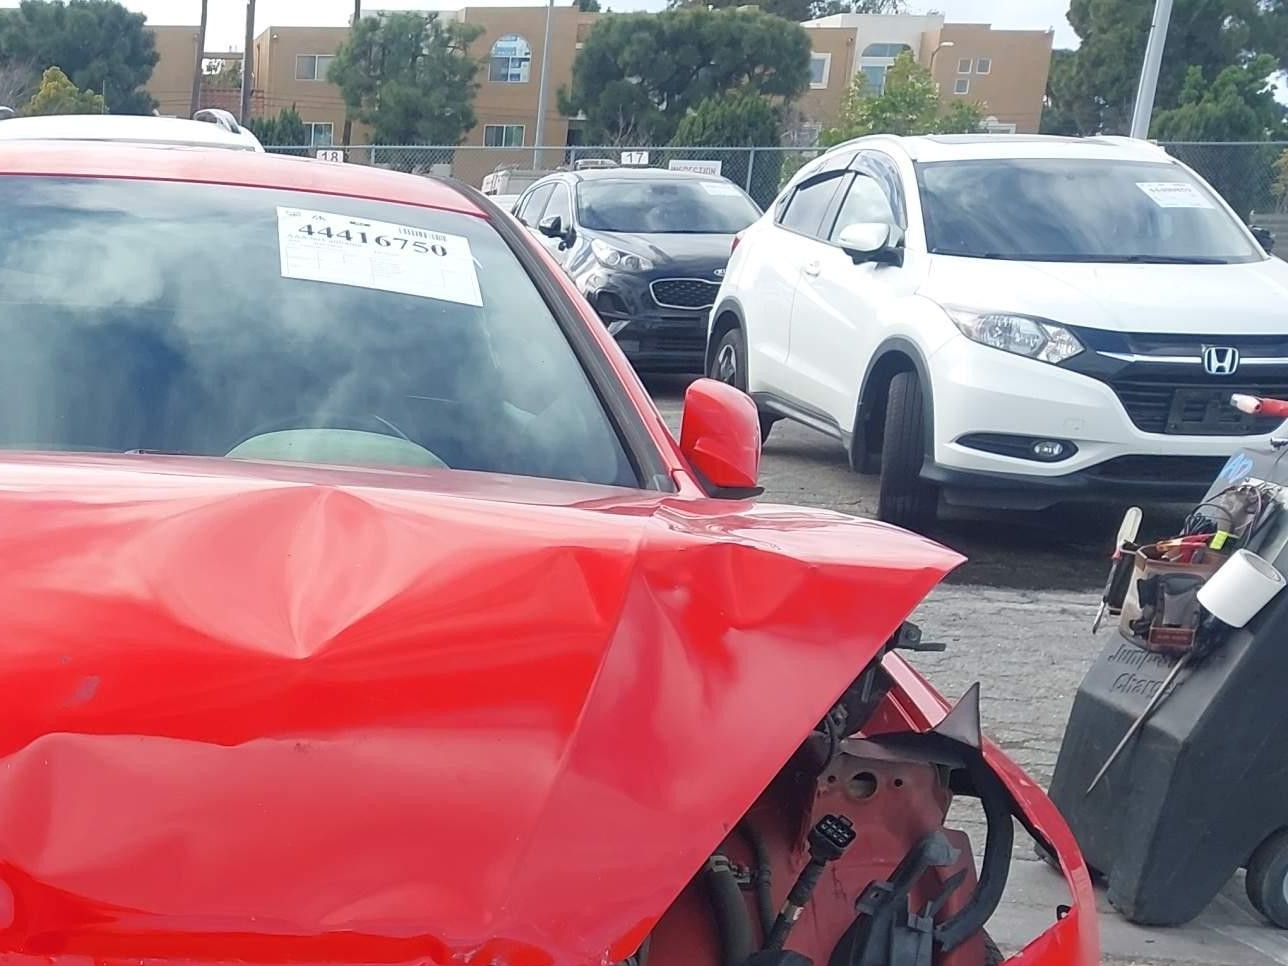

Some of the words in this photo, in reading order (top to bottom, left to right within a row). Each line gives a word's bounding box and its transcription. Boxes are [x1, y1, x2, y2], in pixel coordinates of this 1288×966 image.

[321, 151, 339, 162] 18
[626, 152, 644, 165] 17
[298, 223, 449, 257] 44416750
